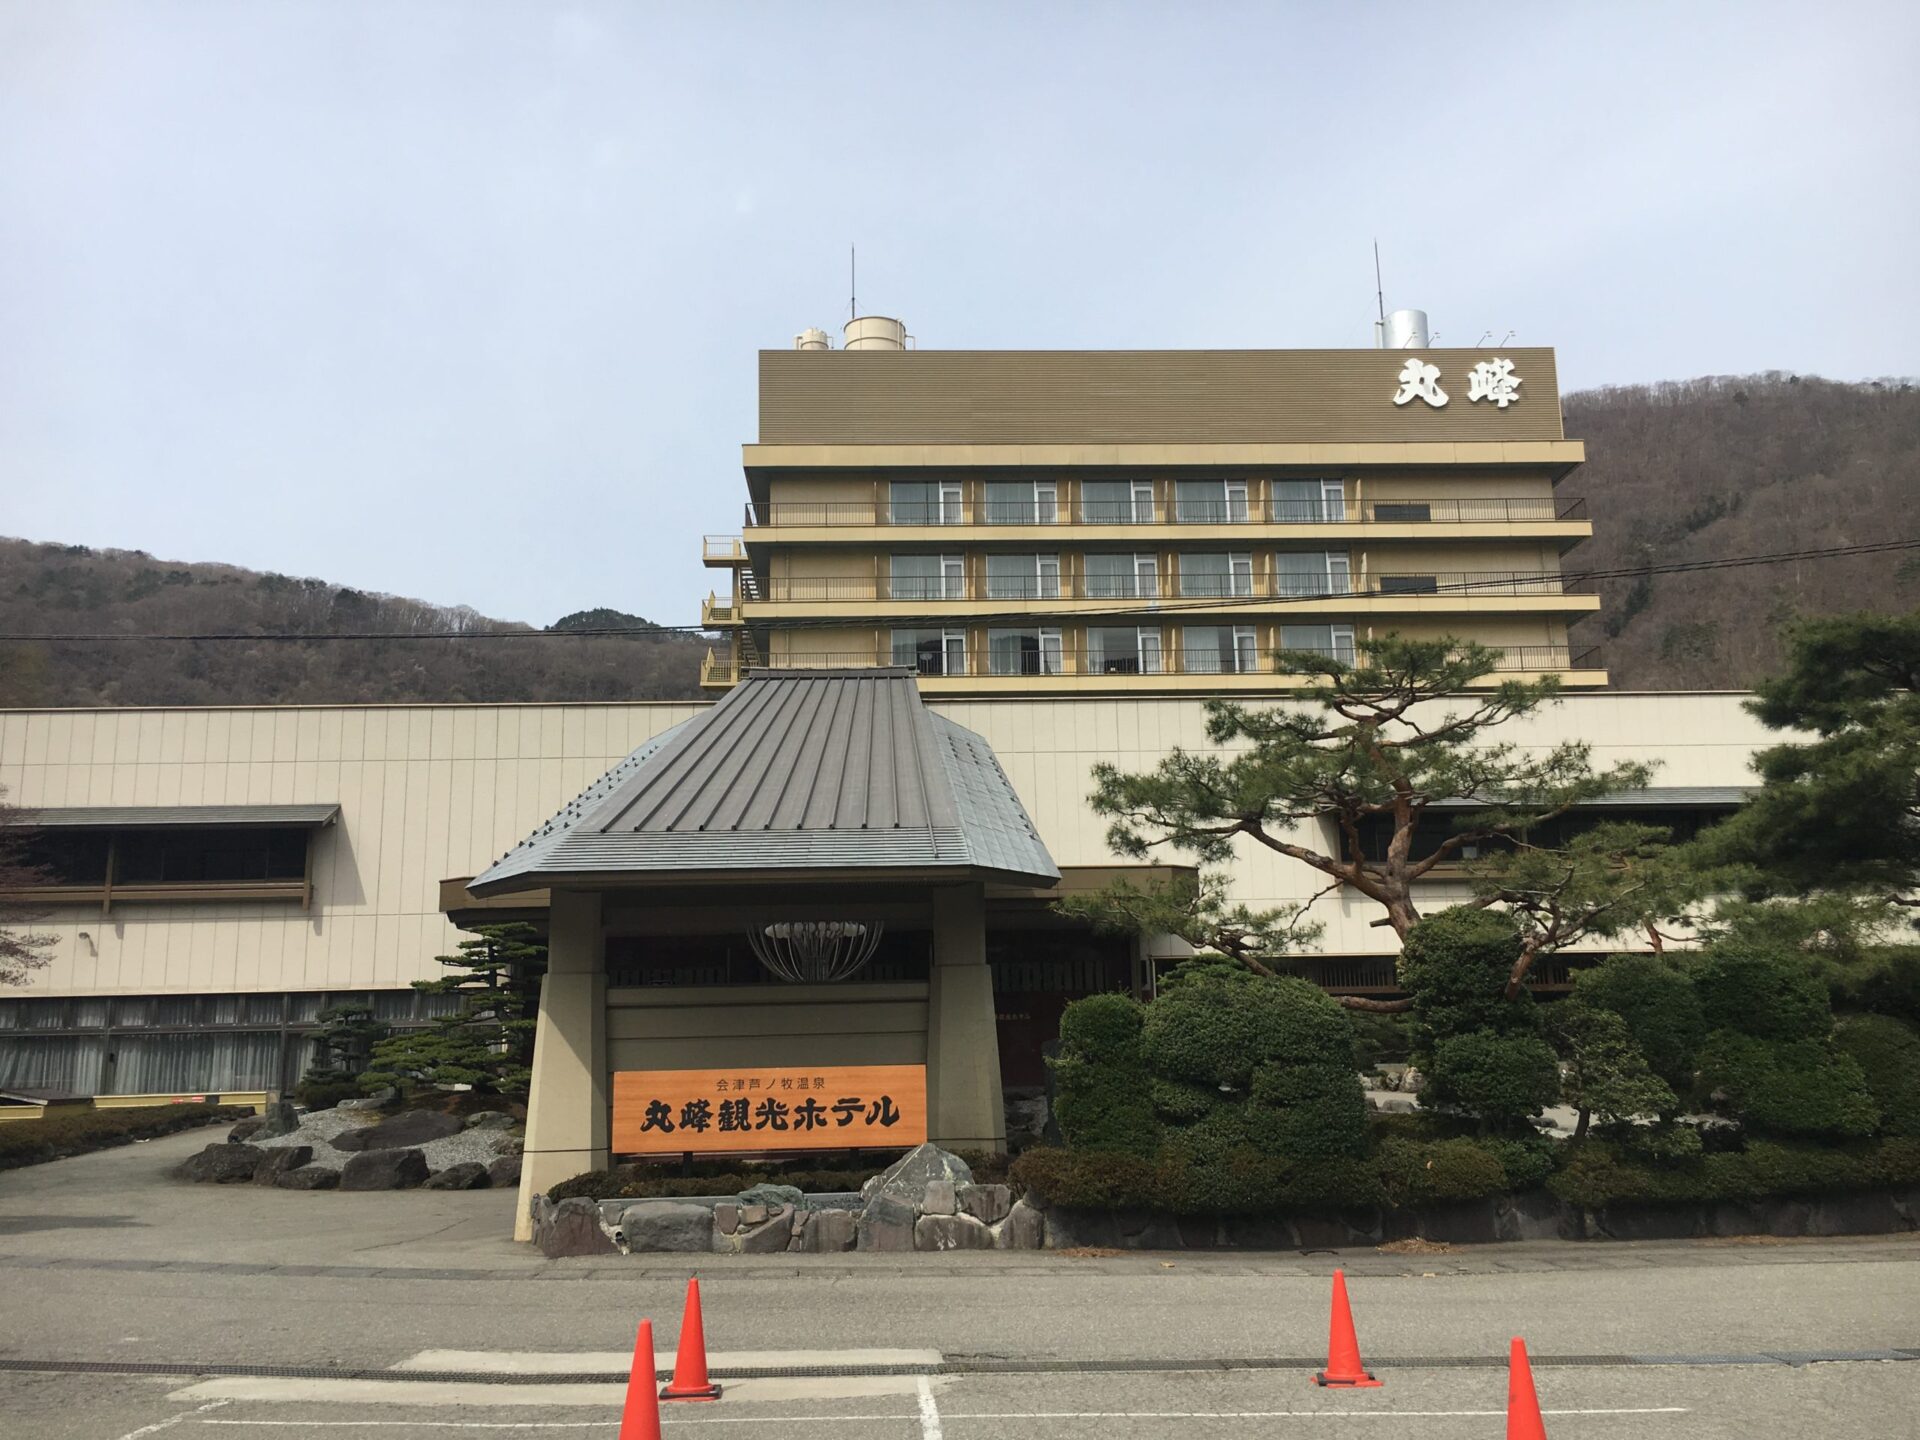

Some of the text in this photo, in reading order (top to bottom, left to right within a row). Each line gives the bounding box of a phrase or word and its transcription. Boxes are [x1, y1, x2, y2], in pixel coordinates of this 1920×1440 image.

[1393, 357, 1523, 408] 丸峰
[716, 1077, 826, 1092] 会津芦ノ牧温泉
[640, 1095, 900, 1133] 丸峰観光ホテル
